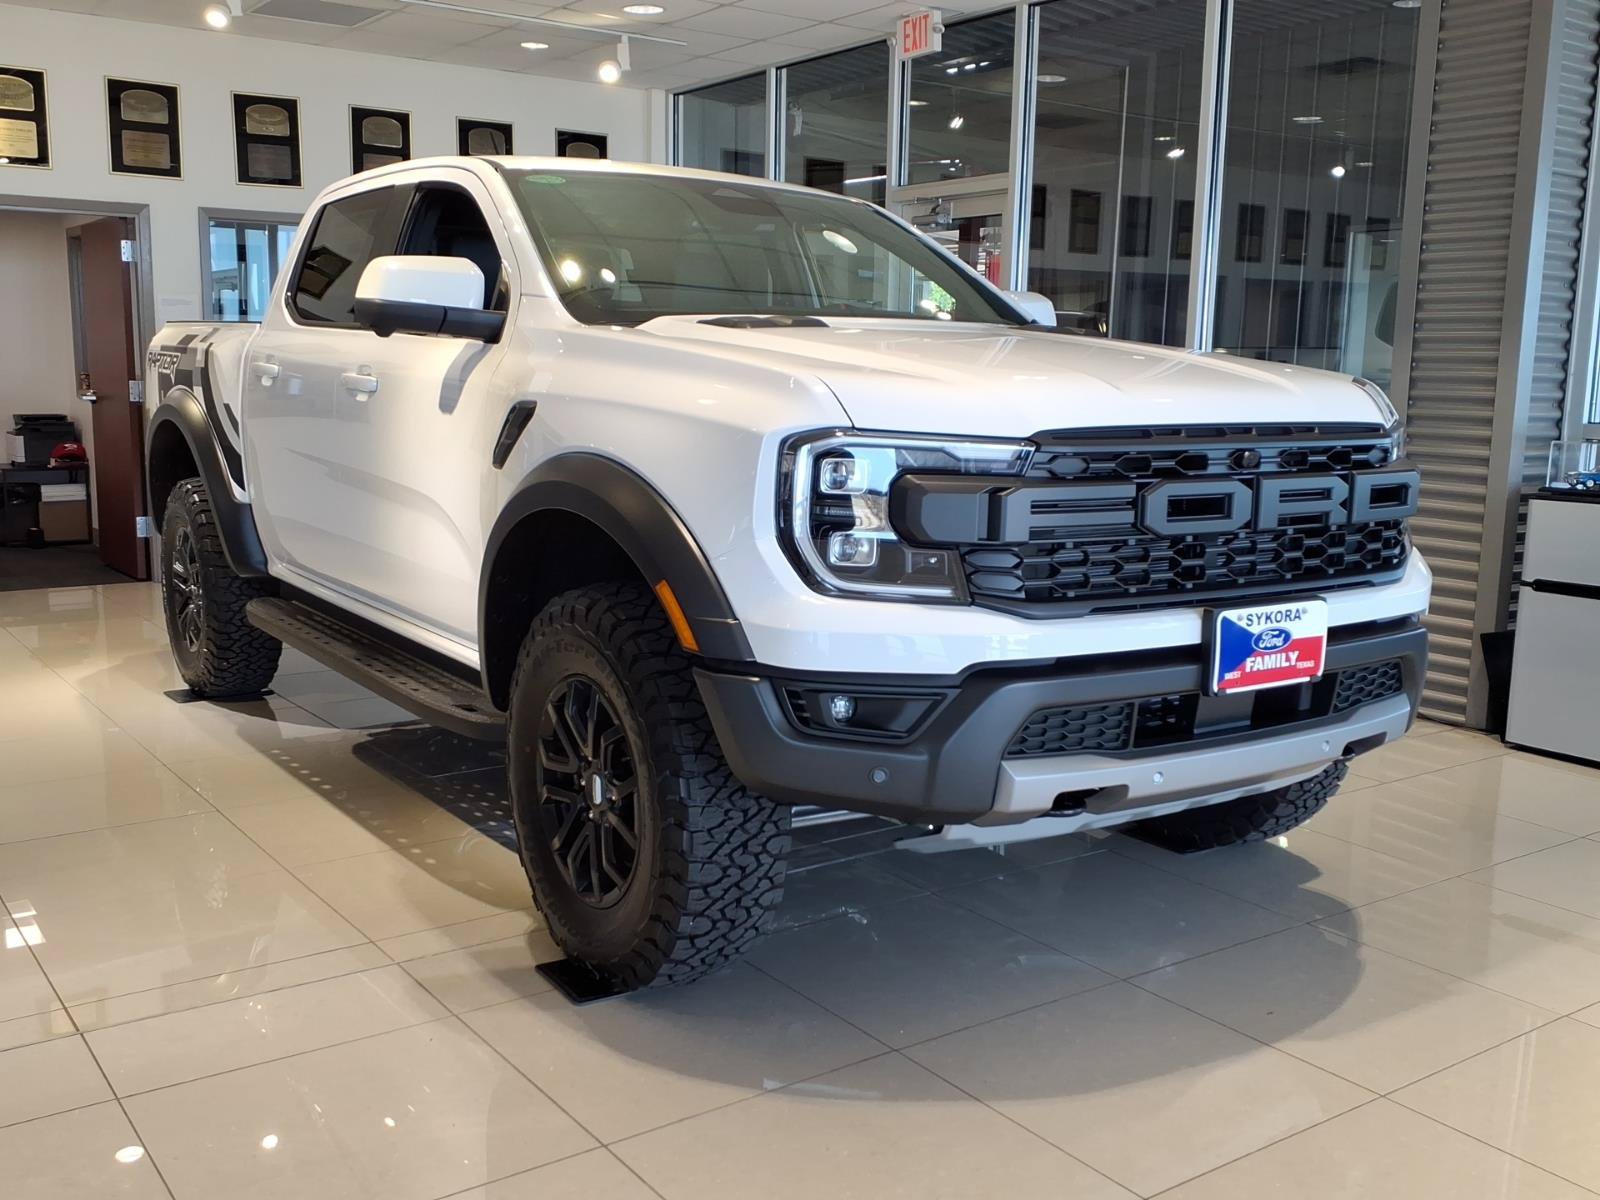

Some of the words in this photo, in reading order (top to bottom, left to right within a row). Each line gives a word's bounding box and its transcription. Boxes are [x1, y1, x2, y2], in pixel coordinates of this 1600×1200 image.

[904, 13, 929, 53] EXIT
[147, 350, 180, 376] RAPTOR
[1001, 468, 1420, 544] FORD
[1245, 608, 1302, 627] SYKORA
[1258, 630, 1285, 648] Ford
[1245, 651, 1300, 672] FAMILY
